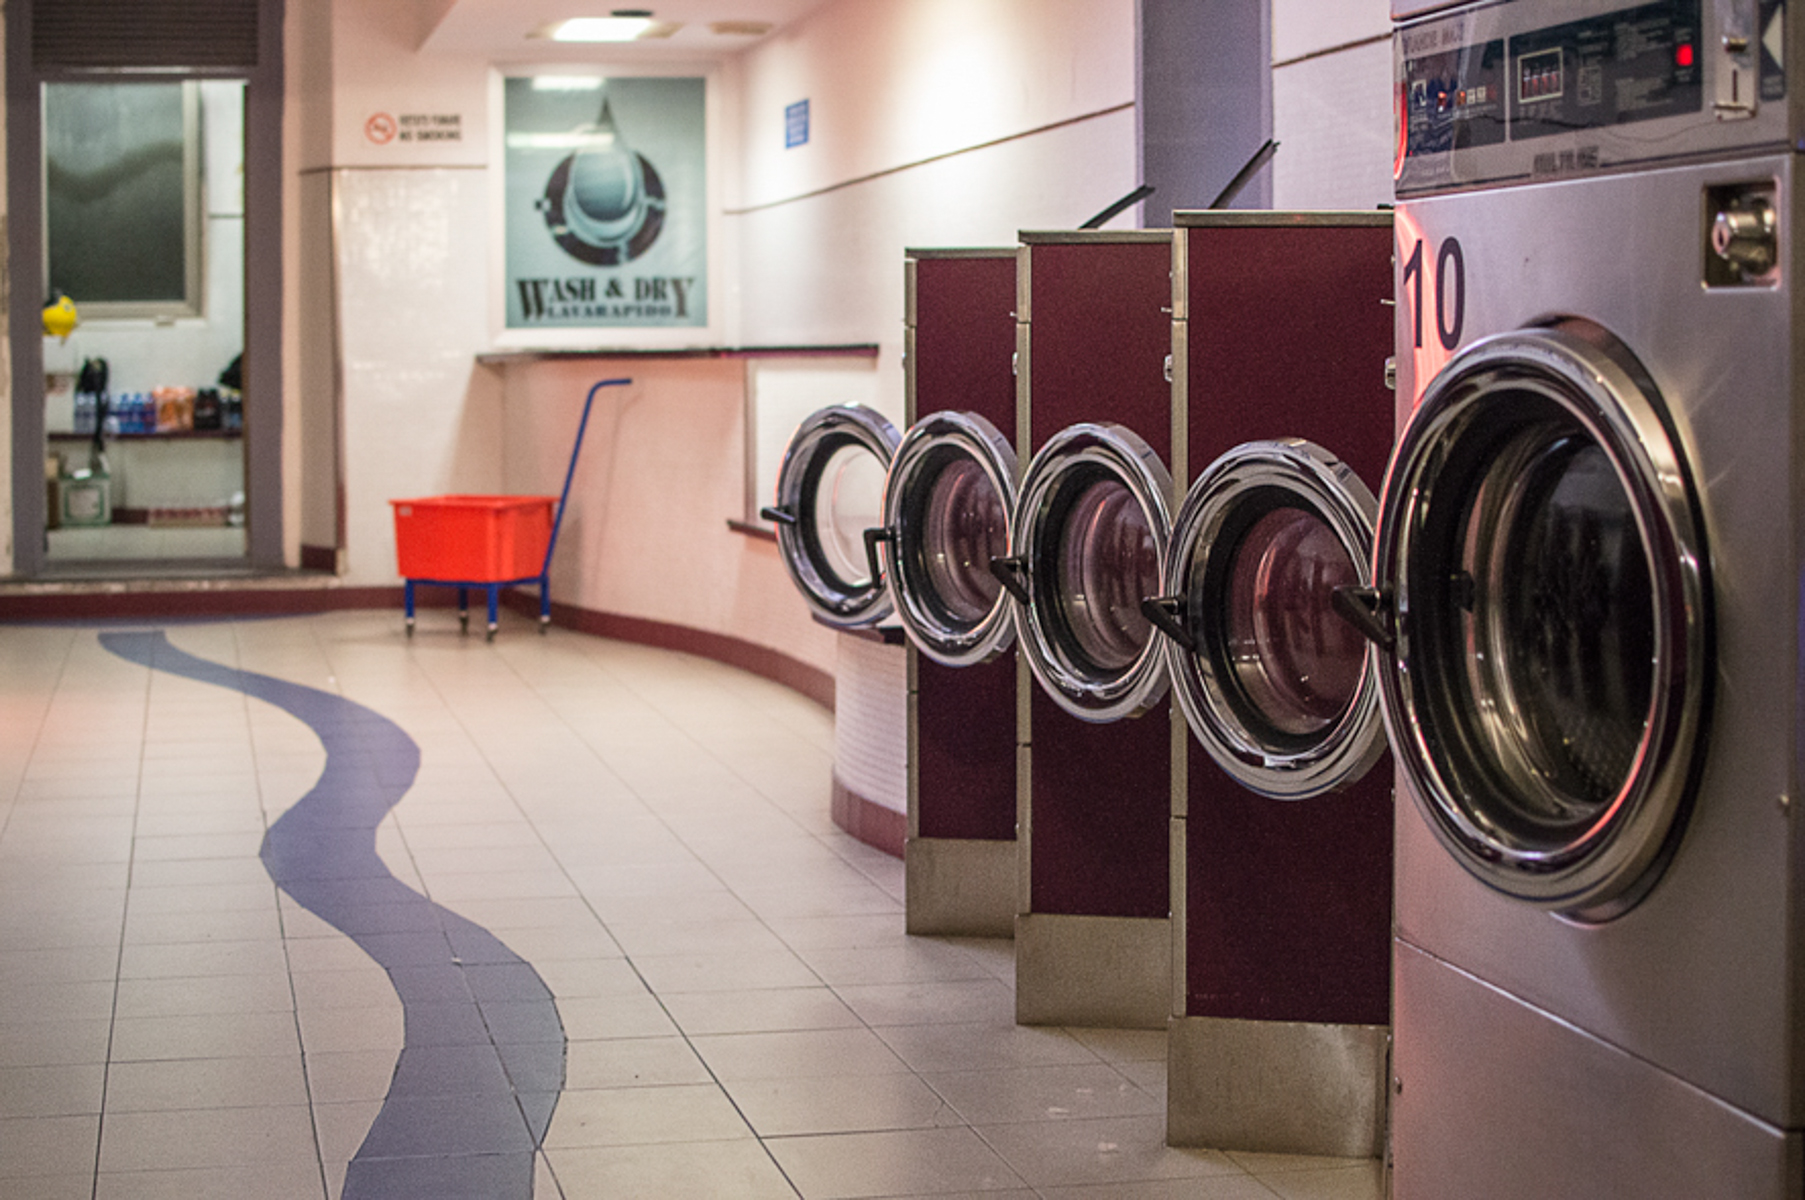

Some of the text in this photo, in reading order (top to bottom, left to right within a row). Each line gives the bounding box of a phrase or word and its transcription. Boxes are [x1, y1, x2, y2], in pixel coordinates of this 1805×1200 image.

[516, 277, 696, 320] WASH & DRY
[548, 303, 671, 319] LAVARAPIDO
[1403, 235, 1466, 351] 10
